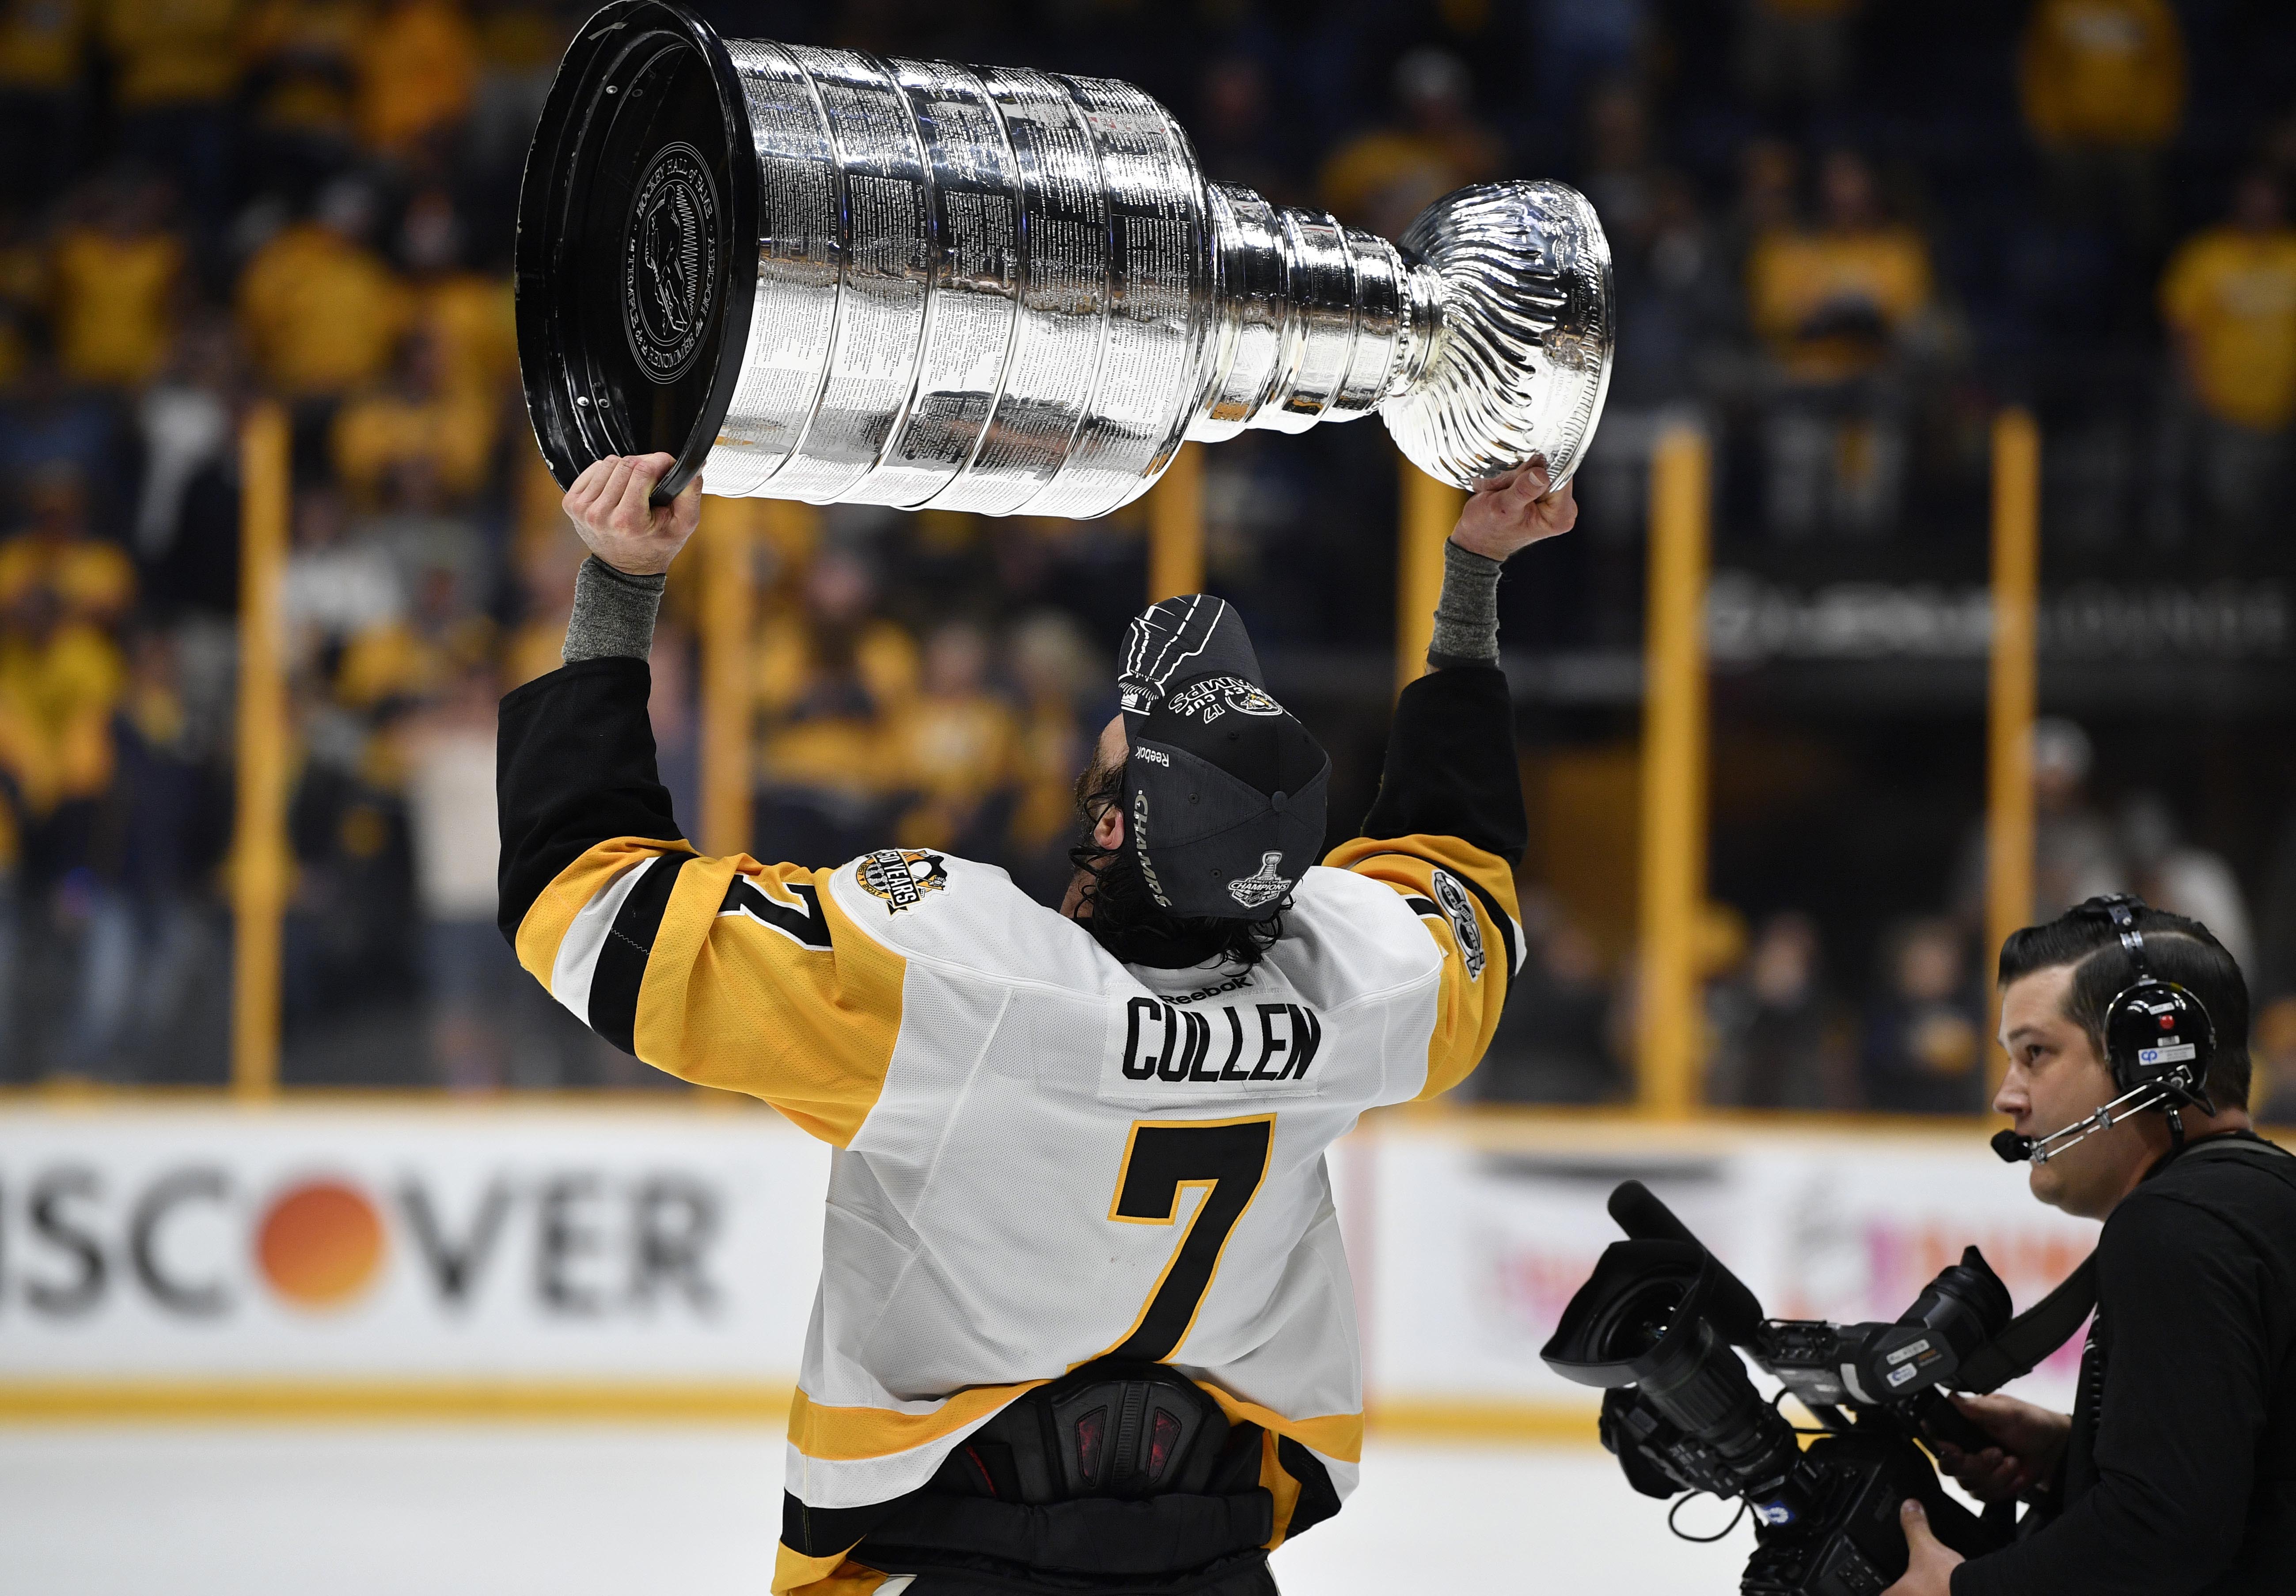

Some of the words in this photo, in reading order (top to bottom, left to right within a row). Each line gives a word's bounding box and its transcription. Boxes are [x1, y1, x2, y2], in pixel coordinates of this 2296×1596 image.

[636, 163, 665, 219] HOCKEY
[666, 158, 688, 175] HALL
[695, 174, 713, 220] FAME
[700, 237, 715, 317] HOCKEY
[907, 332, 918, 361] 1998-99
[998, 332, 1006, 352] OILERS
[988, 354, 1002, 386] 1984-85
[1560, 372, 1574, 406] TTAWA
[1169, 677, 1252, 714] AMPS
[1185, 694, 1216, 716] CUP
[1203, 703, 1226, 724] 17
[1135, 745, 1169, 767] Reebok
[877, 852, 901, 863] 50
[1134, 795, 1172, 906] CHAMPS
[862, 884, 883, 896] 2017
[884, 862, 917, 903] YEARS
[1157, 977, 1253, 1005] Reebok
[1122, 997, 1321, 1082] CULLEN
[1096, 1113, 1278, 1363] 7
